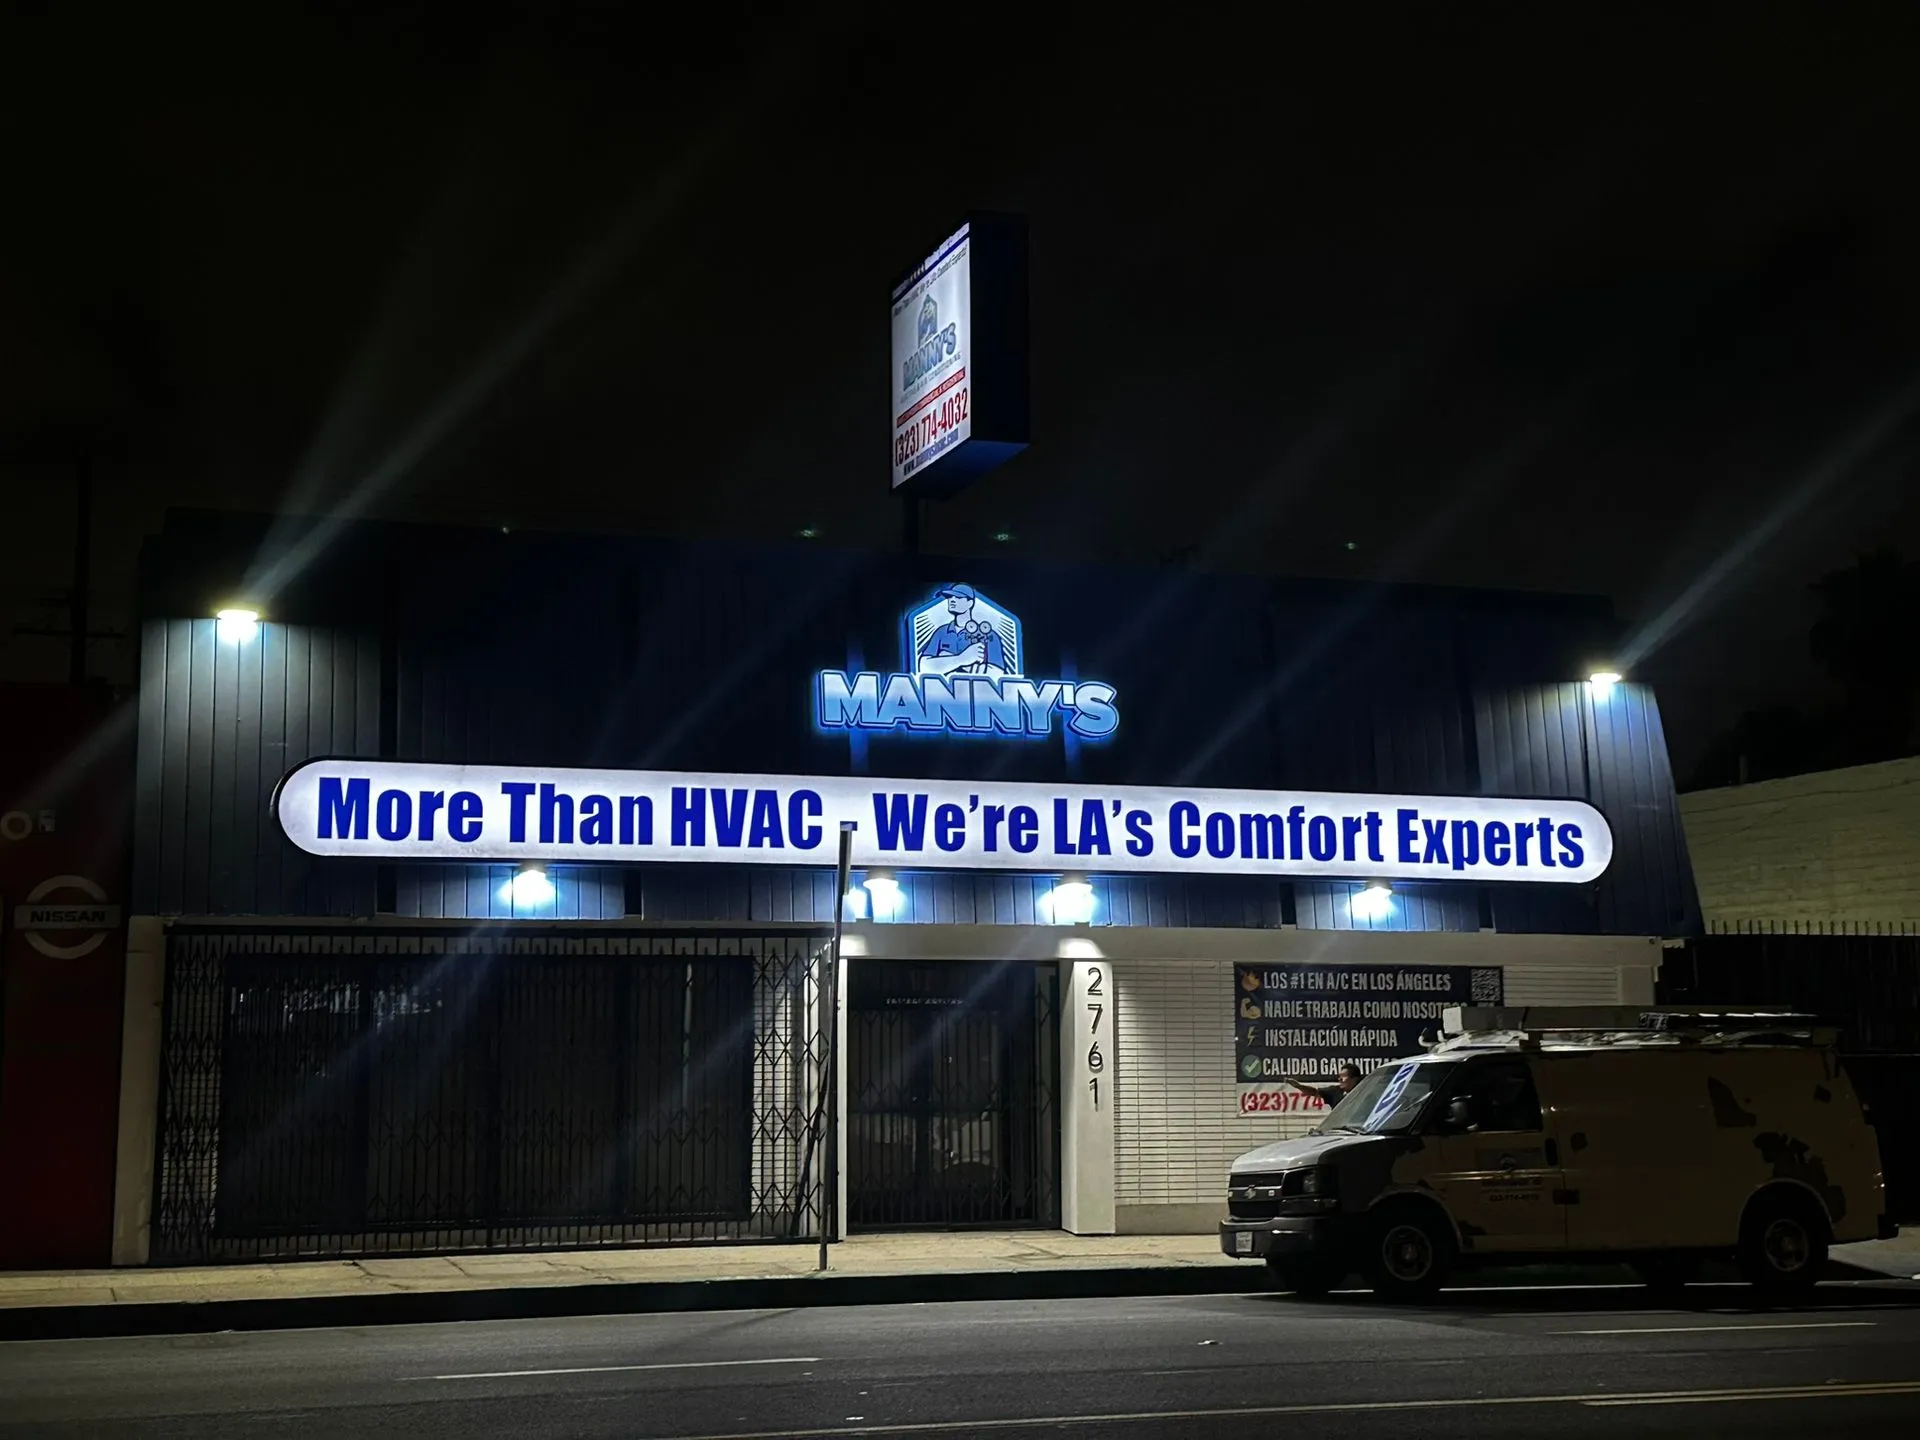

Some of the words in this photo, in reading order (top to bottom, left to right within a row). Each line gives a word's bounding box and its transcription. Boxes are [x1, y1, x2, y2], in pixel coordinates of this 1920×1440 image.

[895, 422, 919, 467] (323)
[922, 387, 968, 448] 774-4032
[817, 669, 1120, 738] MANNY'S
[317, 777, 483, 843] More
[501, 782, 653, 845] Than
[671, 787, 823, 849] HVAC
[872, 793, 1039, 854] We're
[1053, 798, 1154, 857] LA's
[1169, 801, 1384, 862] Comfort
[1397, 808, 1585, 871] Experts
[30, 910, 106, 923] NISSAN
[1263, 971, 1288, 990] LOS
[1290, 972, 1305, 990] #1
[1308, 972, 1323, 990] EN
[1326, 972, 1349, 991] A/C
[1352, 973, 1368, 991] EN
[1370, 973, 1394, 991] LOS
[1396, 969, 1452, 992] ÁNGELES
[1264, 1001, 1303, 1019] NADIE
[1306, 1001, 1361, 1019] TRABAJA
[1363, 1001, 1400, 1019] COMO
[1087, 966, 1105, 1107] 2761
[1265, 1026, 1348, 1048] INSTALACIÓN
[1351, 1026, 1398, 1048] RÁPIDA
[1262, 1057, 1317, 1076] CALIDAD
